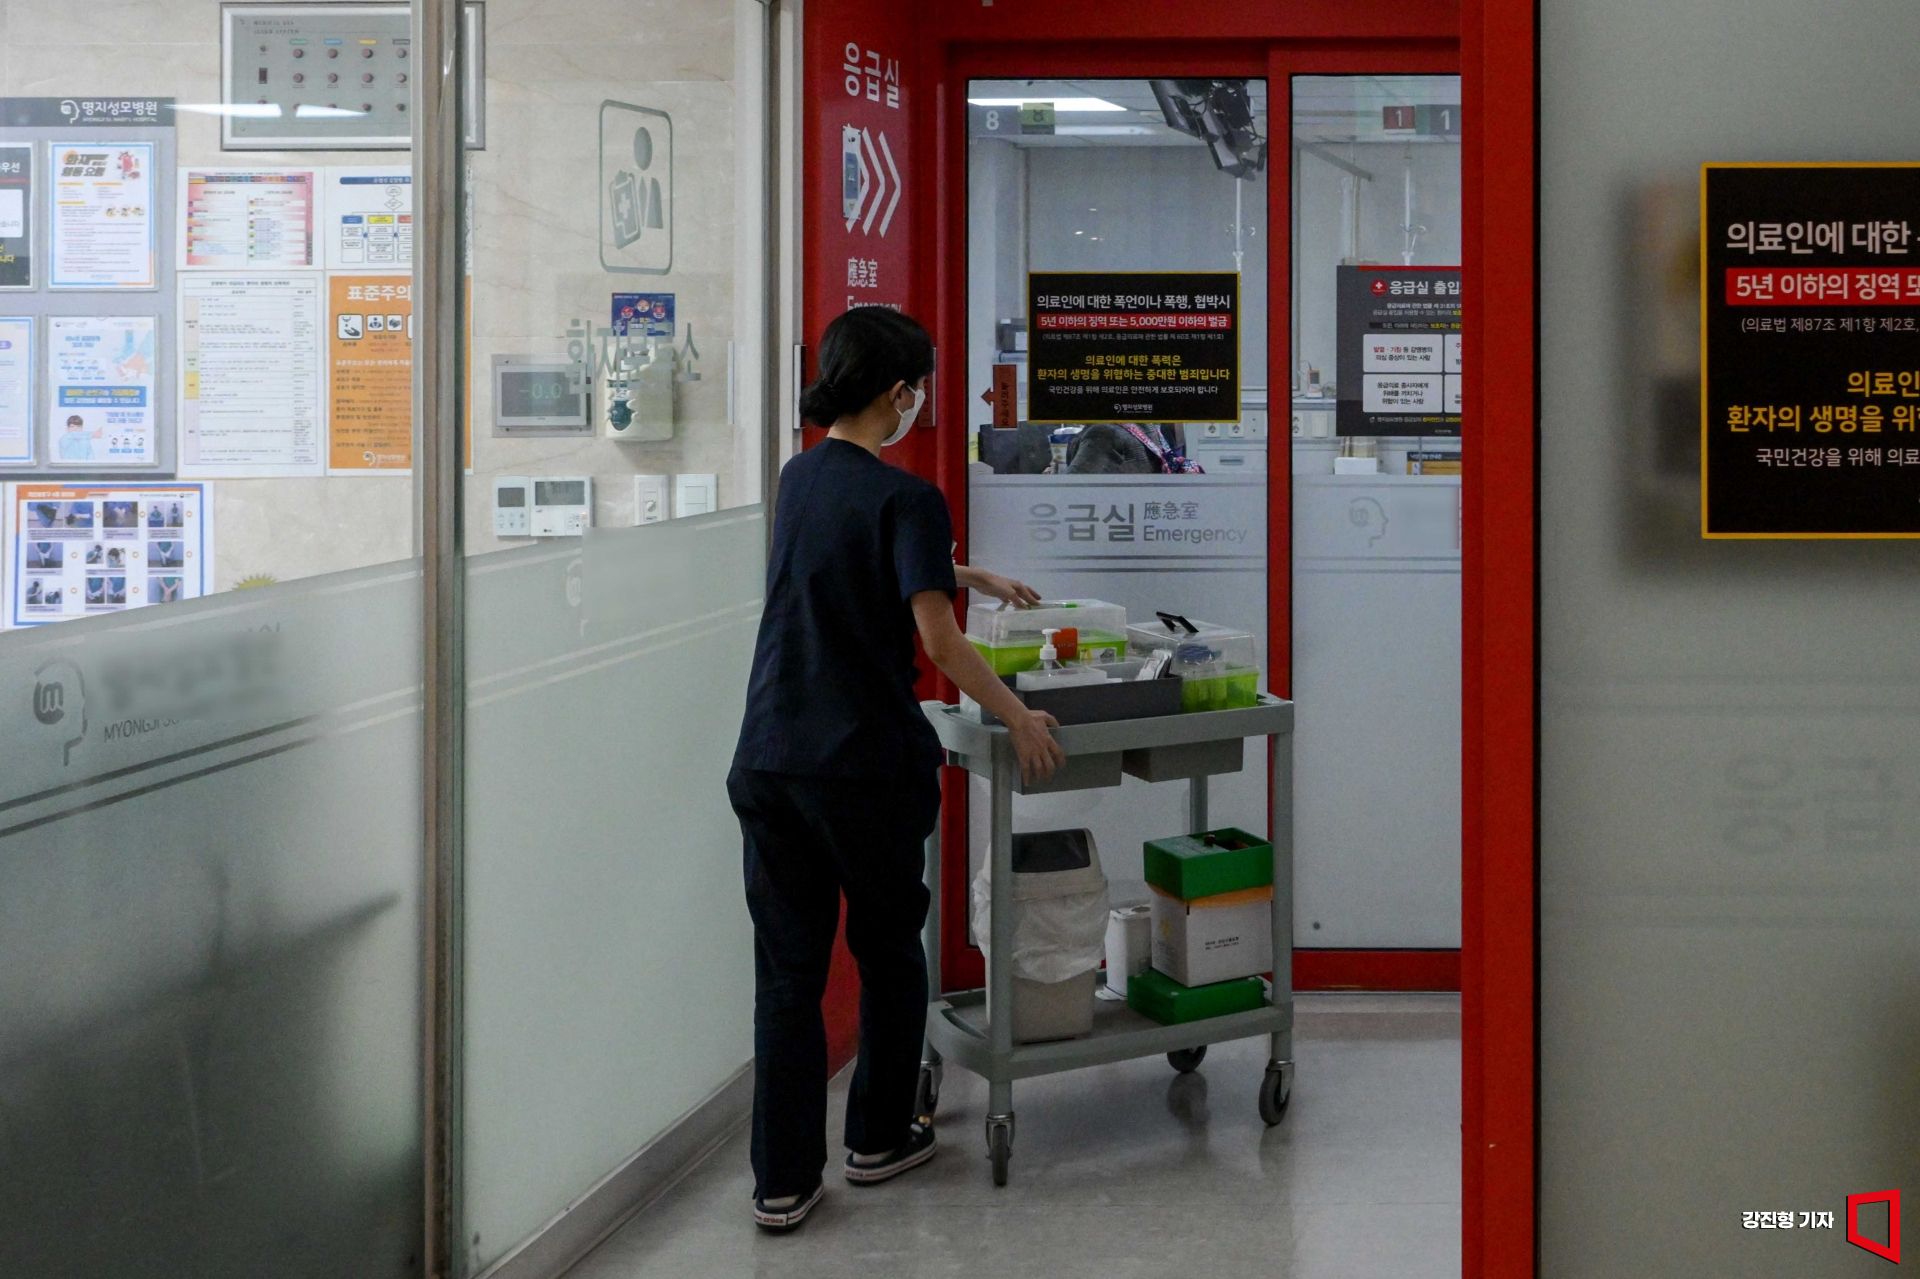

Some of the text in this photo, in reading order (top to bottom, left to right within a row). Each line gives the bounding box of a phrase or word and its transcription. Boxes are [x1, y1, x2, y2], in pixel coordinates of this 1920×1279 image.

[843, 41, 899, 109] 응급실
[82, 101, 158, 116] 명지성모병원
[986, 110, 1000, 130] 8
[1440, 109, 1450, 130] 1
[0, 161, 21, 173] 우선
[1727, 221, 1910, 254] 의료인에 대한
[847, 257, 878, 288] 應急室
[347, 285, 412, 302] 표준주의
[1389, 281, 1461, 295] 응급실 출입
[1737, 274, 1773, 300] 5년
[1781, 274, 1848, 300] 이하의
[1855, 274, 1899, 300] 징역
[1037, 295, 1230, 309] 의료인에 대한 폭언이나 폭행, 협박시
[1041, 316, 1227, 328] 5년 이하의 징역 또는 5,000만원 이하의 벌금
[1742, 318, 1920, 333] (의료법 제87조 제1항 제2호,
[1085, 355, 1182, 366] 의료인에 대한 폭력은
[1037, 369, 1230, 381] 환자의 생명을 위협하는 중대한 범죄입니다
[1848, 371, 1920, 398] 의료인
[1727, 406, 1920, 432] 환자의 생명을 위
[1756, 448, 1920, 467] 국민건강을 위해 의료
[1143, 501, 1199, 521] 應急室
[1026, 502, 1135, 542] 응급실
[1143, 525, 1247, 544] Emergency
